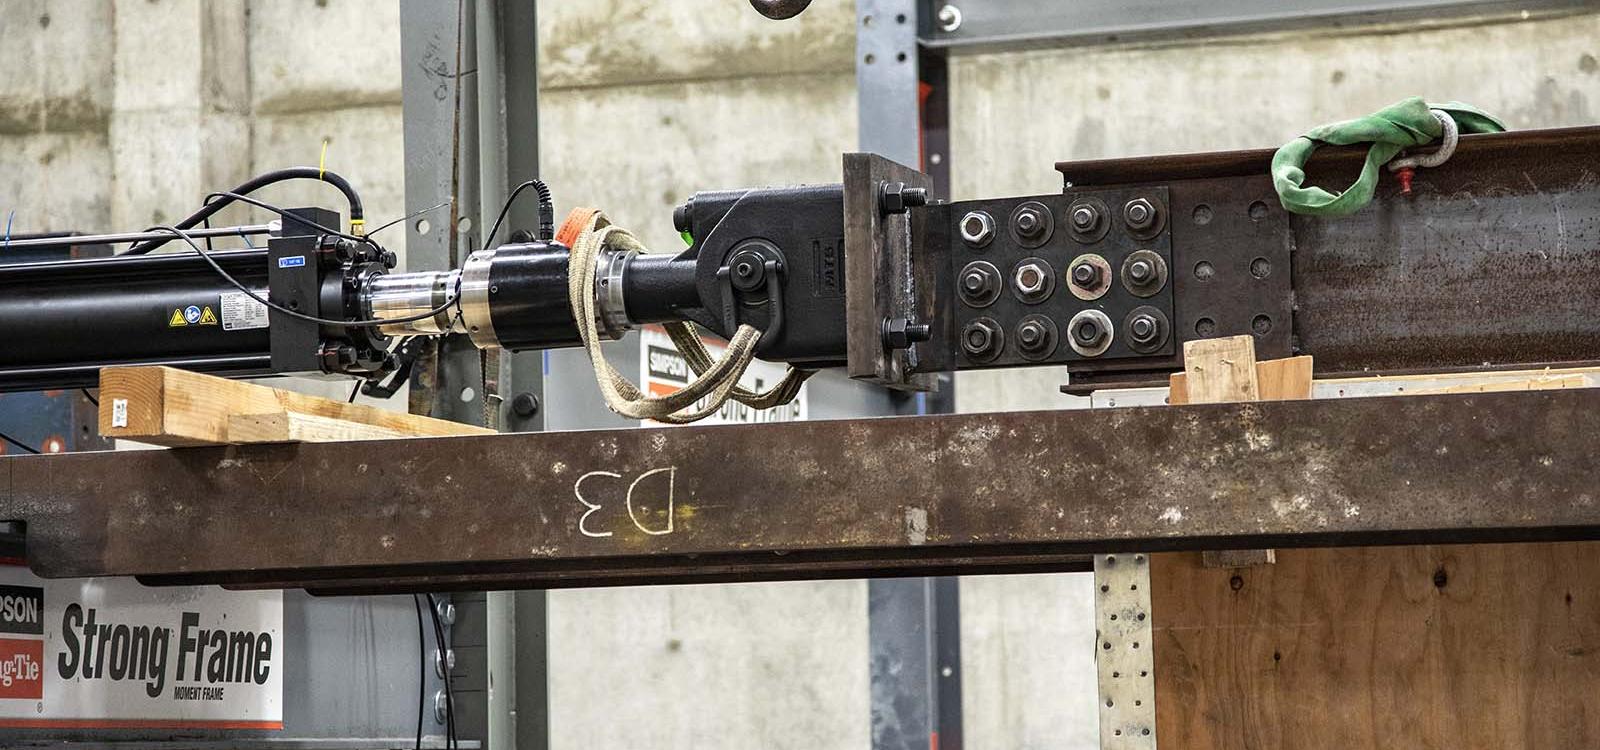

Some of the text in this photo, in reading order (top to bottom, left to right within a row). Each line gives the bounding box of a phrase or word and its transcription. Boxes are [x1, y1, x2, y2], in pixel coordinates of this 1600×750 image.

[650, 351, 687, 377] SIMPSON
[574, 466, 677, 538] D3
[0, 594, 37, 623] SON
[57, 602, 273, 698] Strong Frame
[174, 686, 224, 701] MOMENT FRAME
